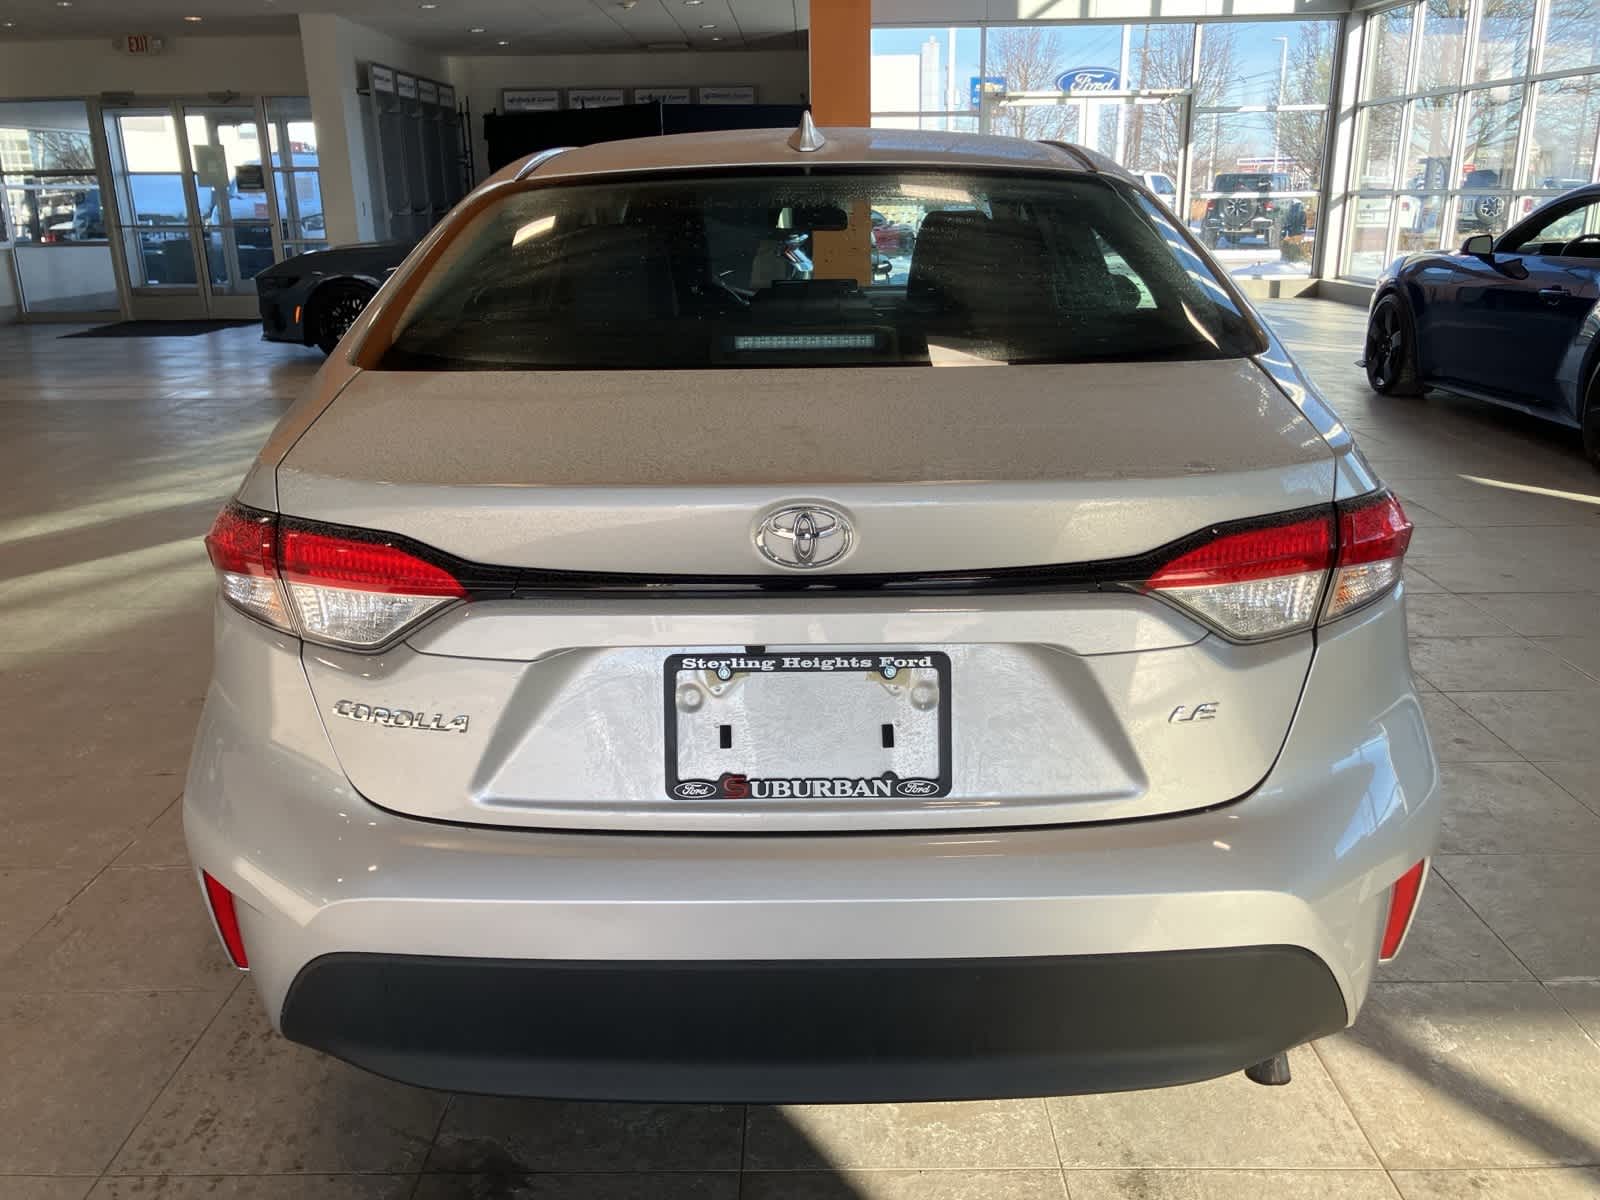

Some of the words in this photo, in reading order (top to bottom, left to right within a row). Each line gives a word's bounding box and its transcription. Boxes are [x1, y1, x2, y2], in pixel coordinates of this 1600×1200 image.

[127, 35, 148, 53] EXIT
[1070, 73, 1116, 90] Ford
[682, 657, 775, 670] Sterling
[782, 656, 872, 669] Heights
[879, 656, 932, 668] Ford
[332, 699, 469, 733] COROLLA
[1168, 701, 1220, 723] LE
[682, 784, 709, 795] Ford
[723, 775, 893, 799] SUBURBAN
[904, 782, 931, 793] Ford
